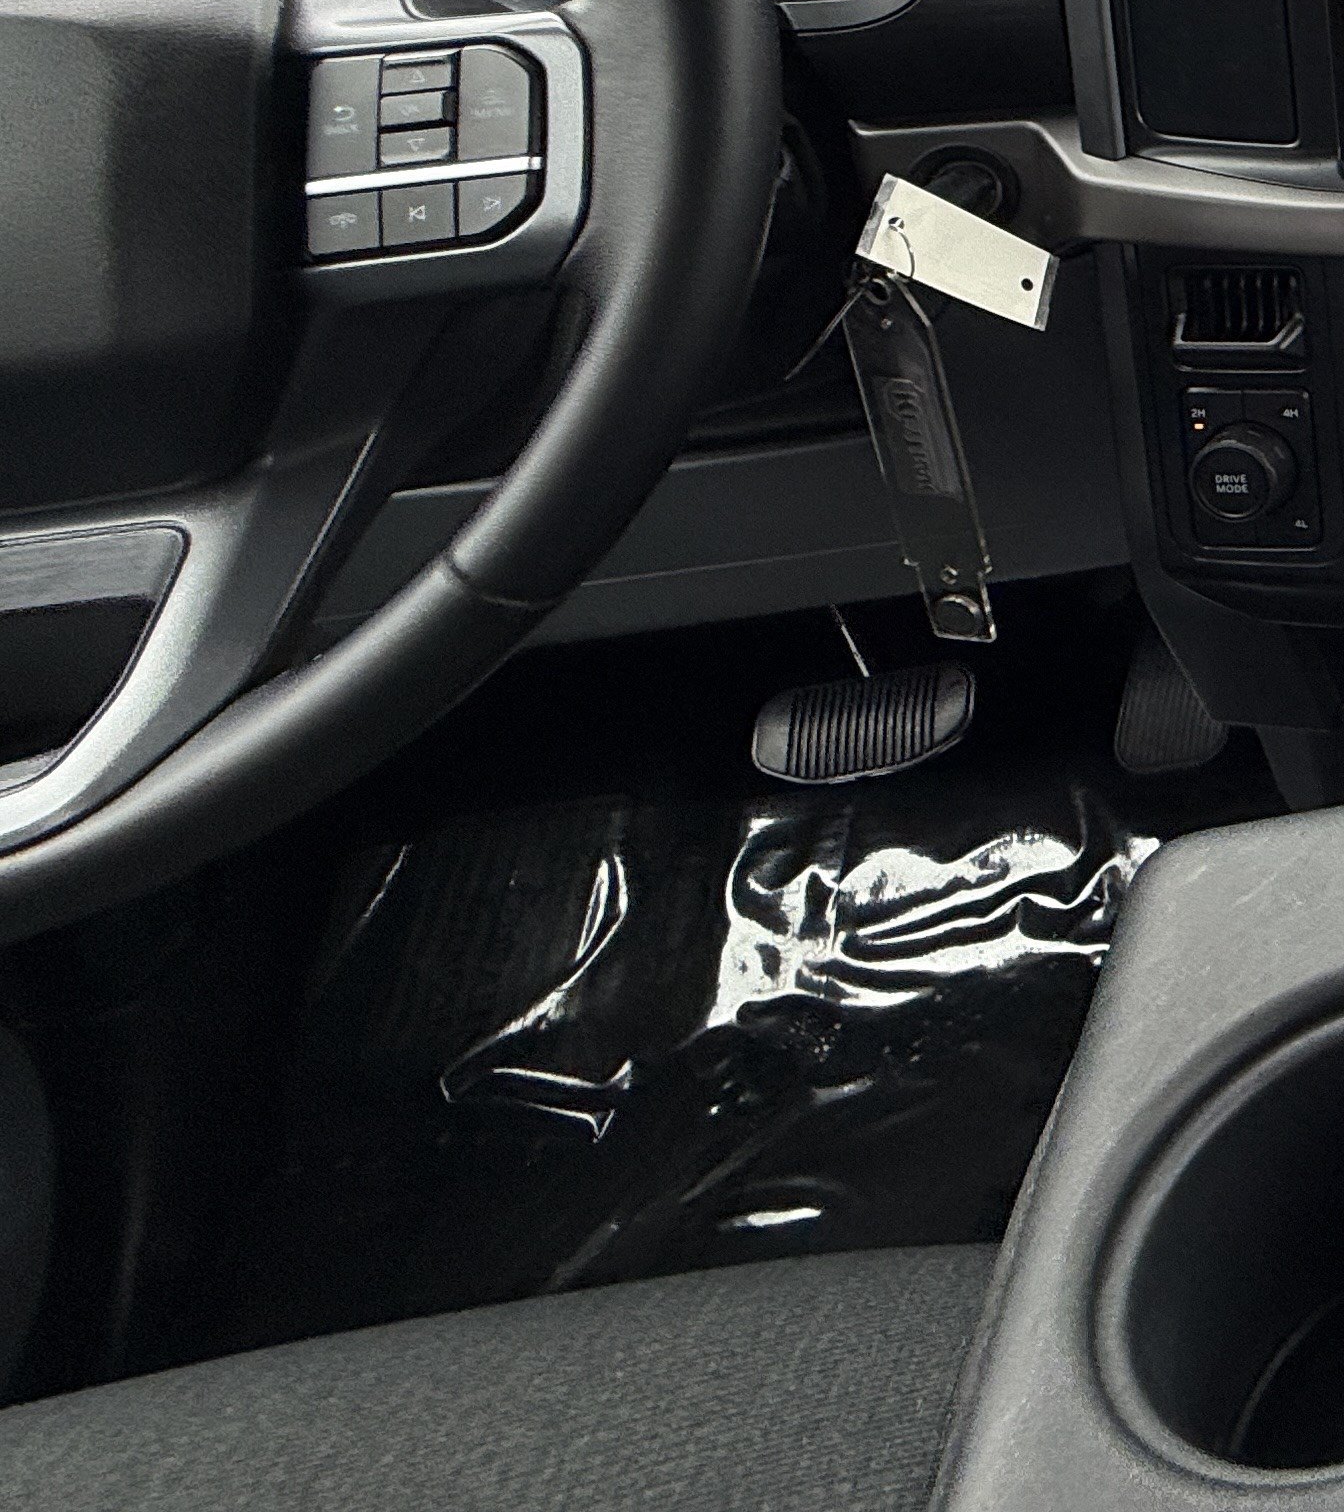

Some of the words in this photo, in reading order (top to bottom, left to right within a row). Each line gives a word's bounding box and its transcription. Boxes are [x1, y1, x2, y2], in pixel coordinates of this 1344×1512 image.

[1191, 408, 1206, 418] 2H
[1282, 408, 1299, 418] 4H
[1215, 474, 1247, 484] DRIVE
[1216, 484, 1249, 494] MODE
